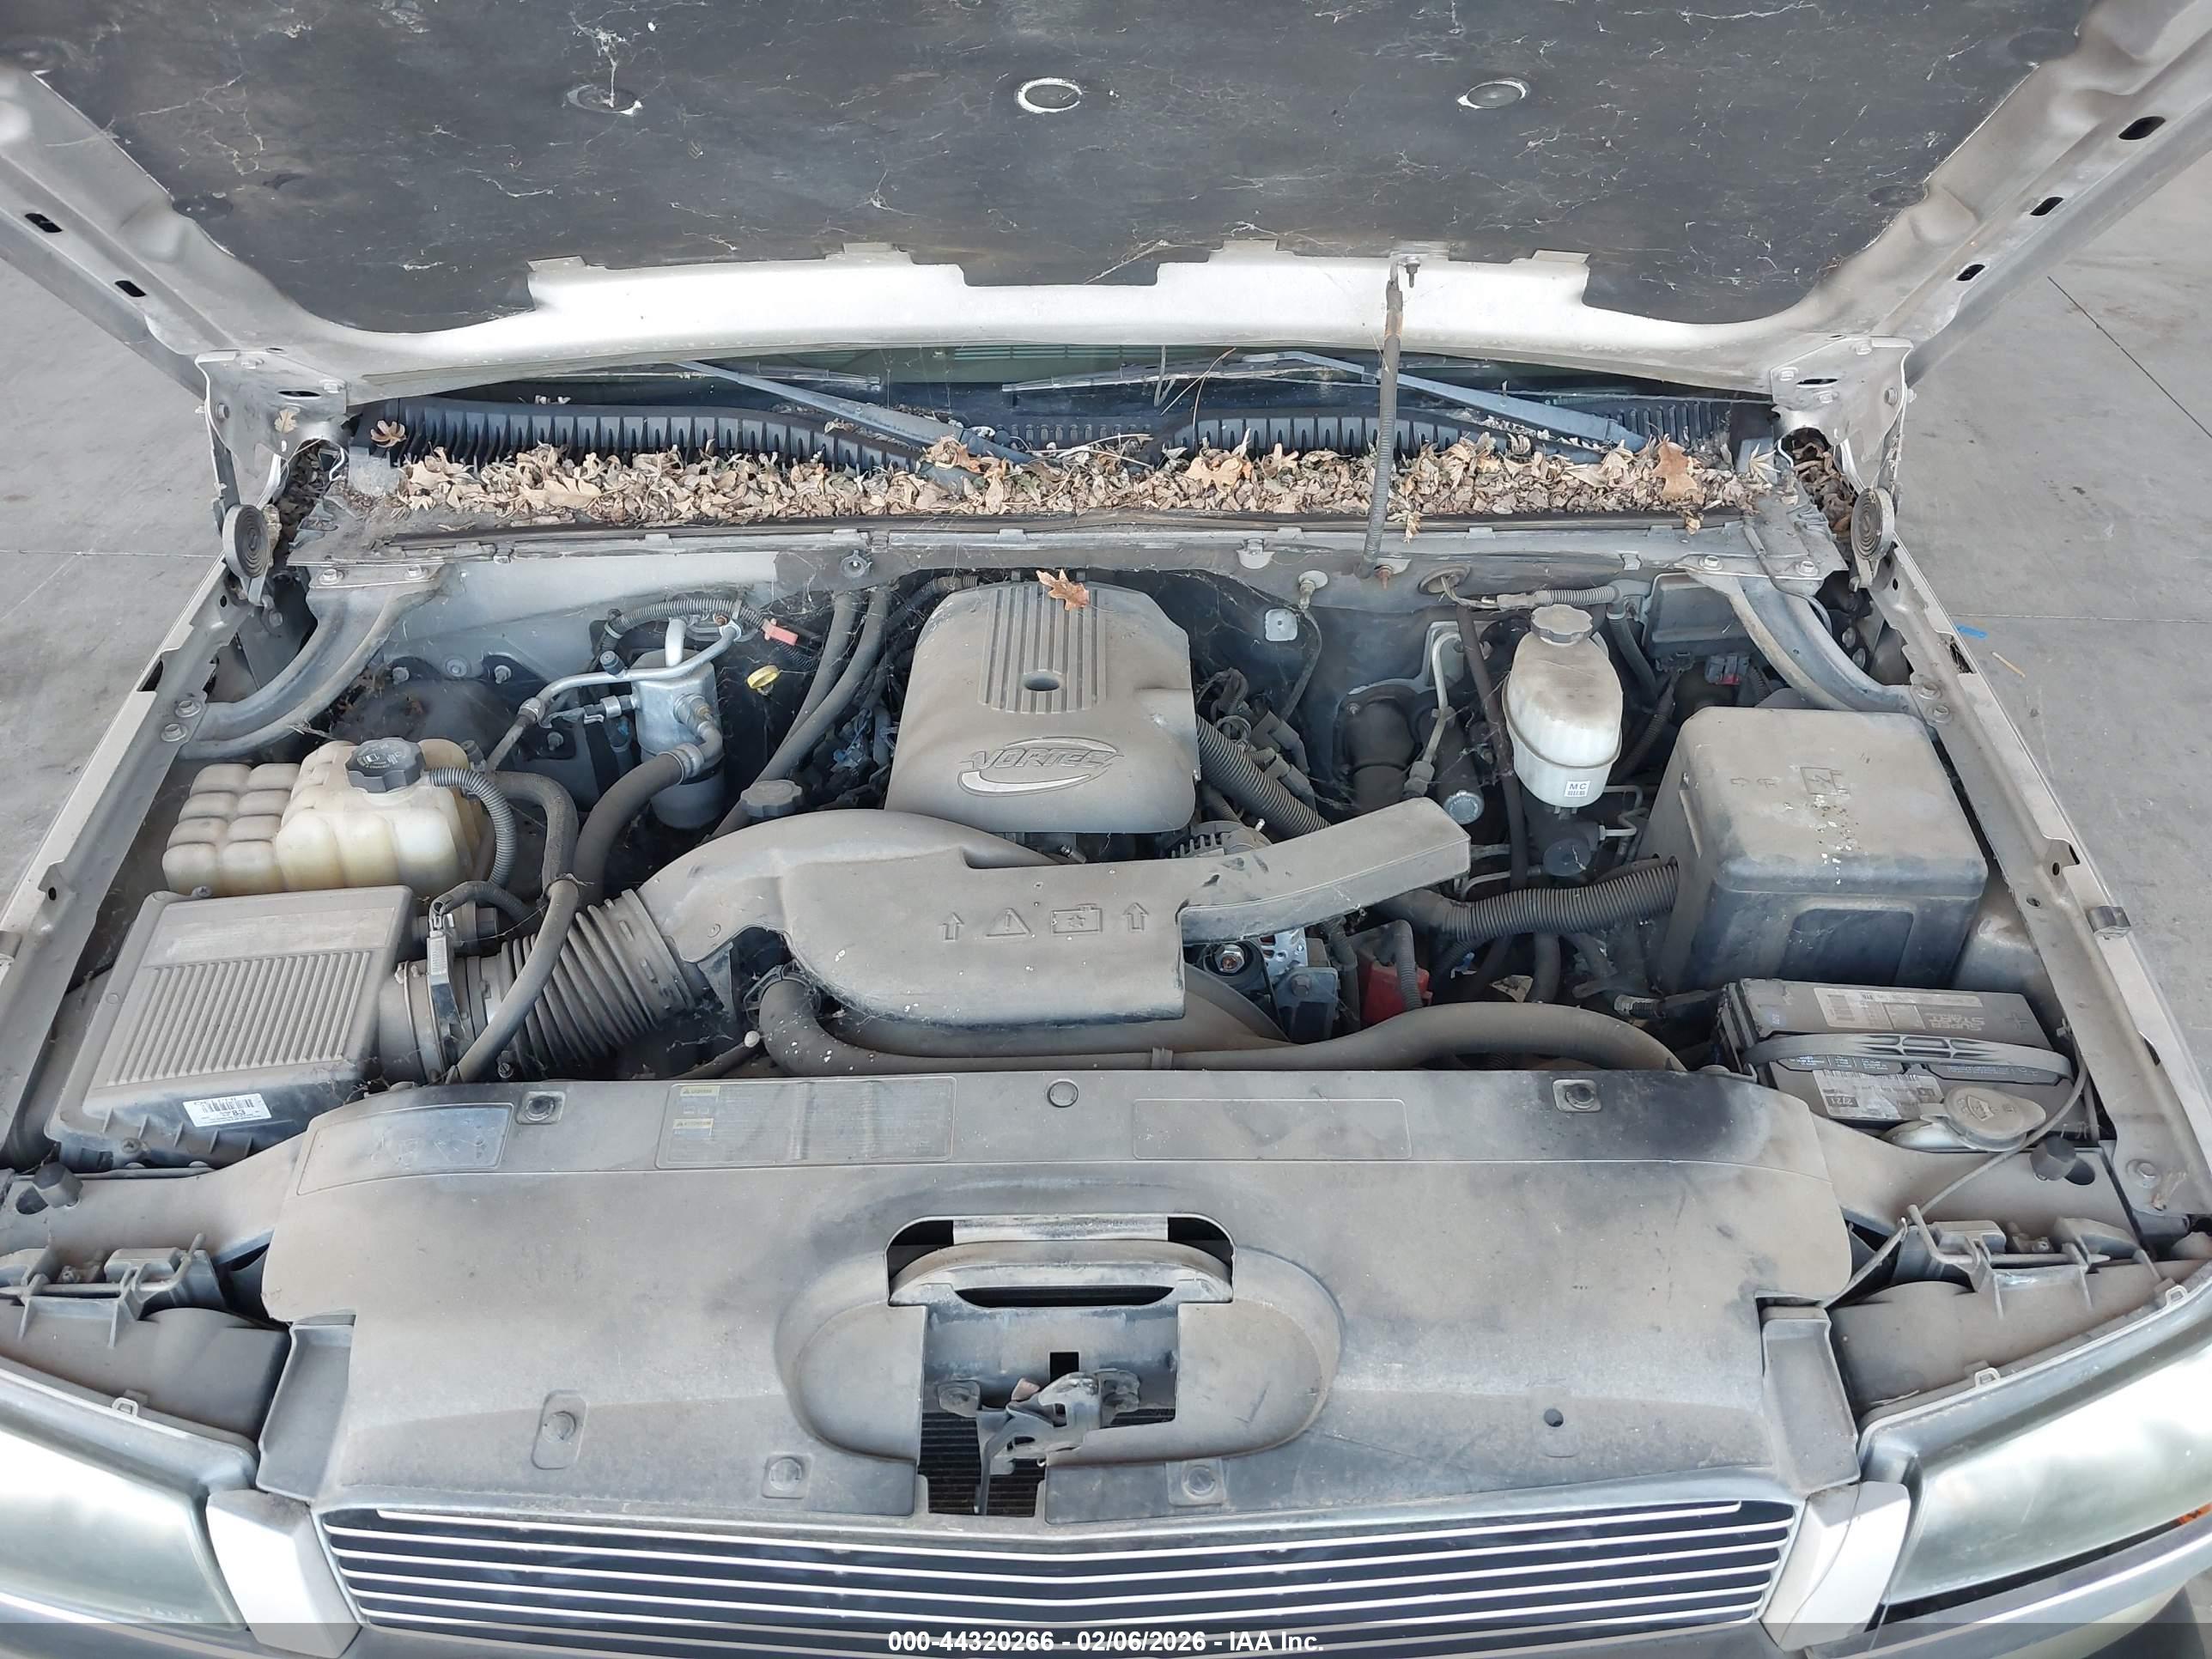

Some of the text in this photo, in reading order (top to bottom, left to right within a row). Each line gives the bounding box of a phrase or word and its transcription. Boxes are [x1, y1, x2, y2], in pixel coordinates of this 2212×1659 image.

[963, 747, 1119, 769] VORTEC
[1929, 1015, 1985, 1026] START
[1930, 1022, 1982, 1031] SUPER
